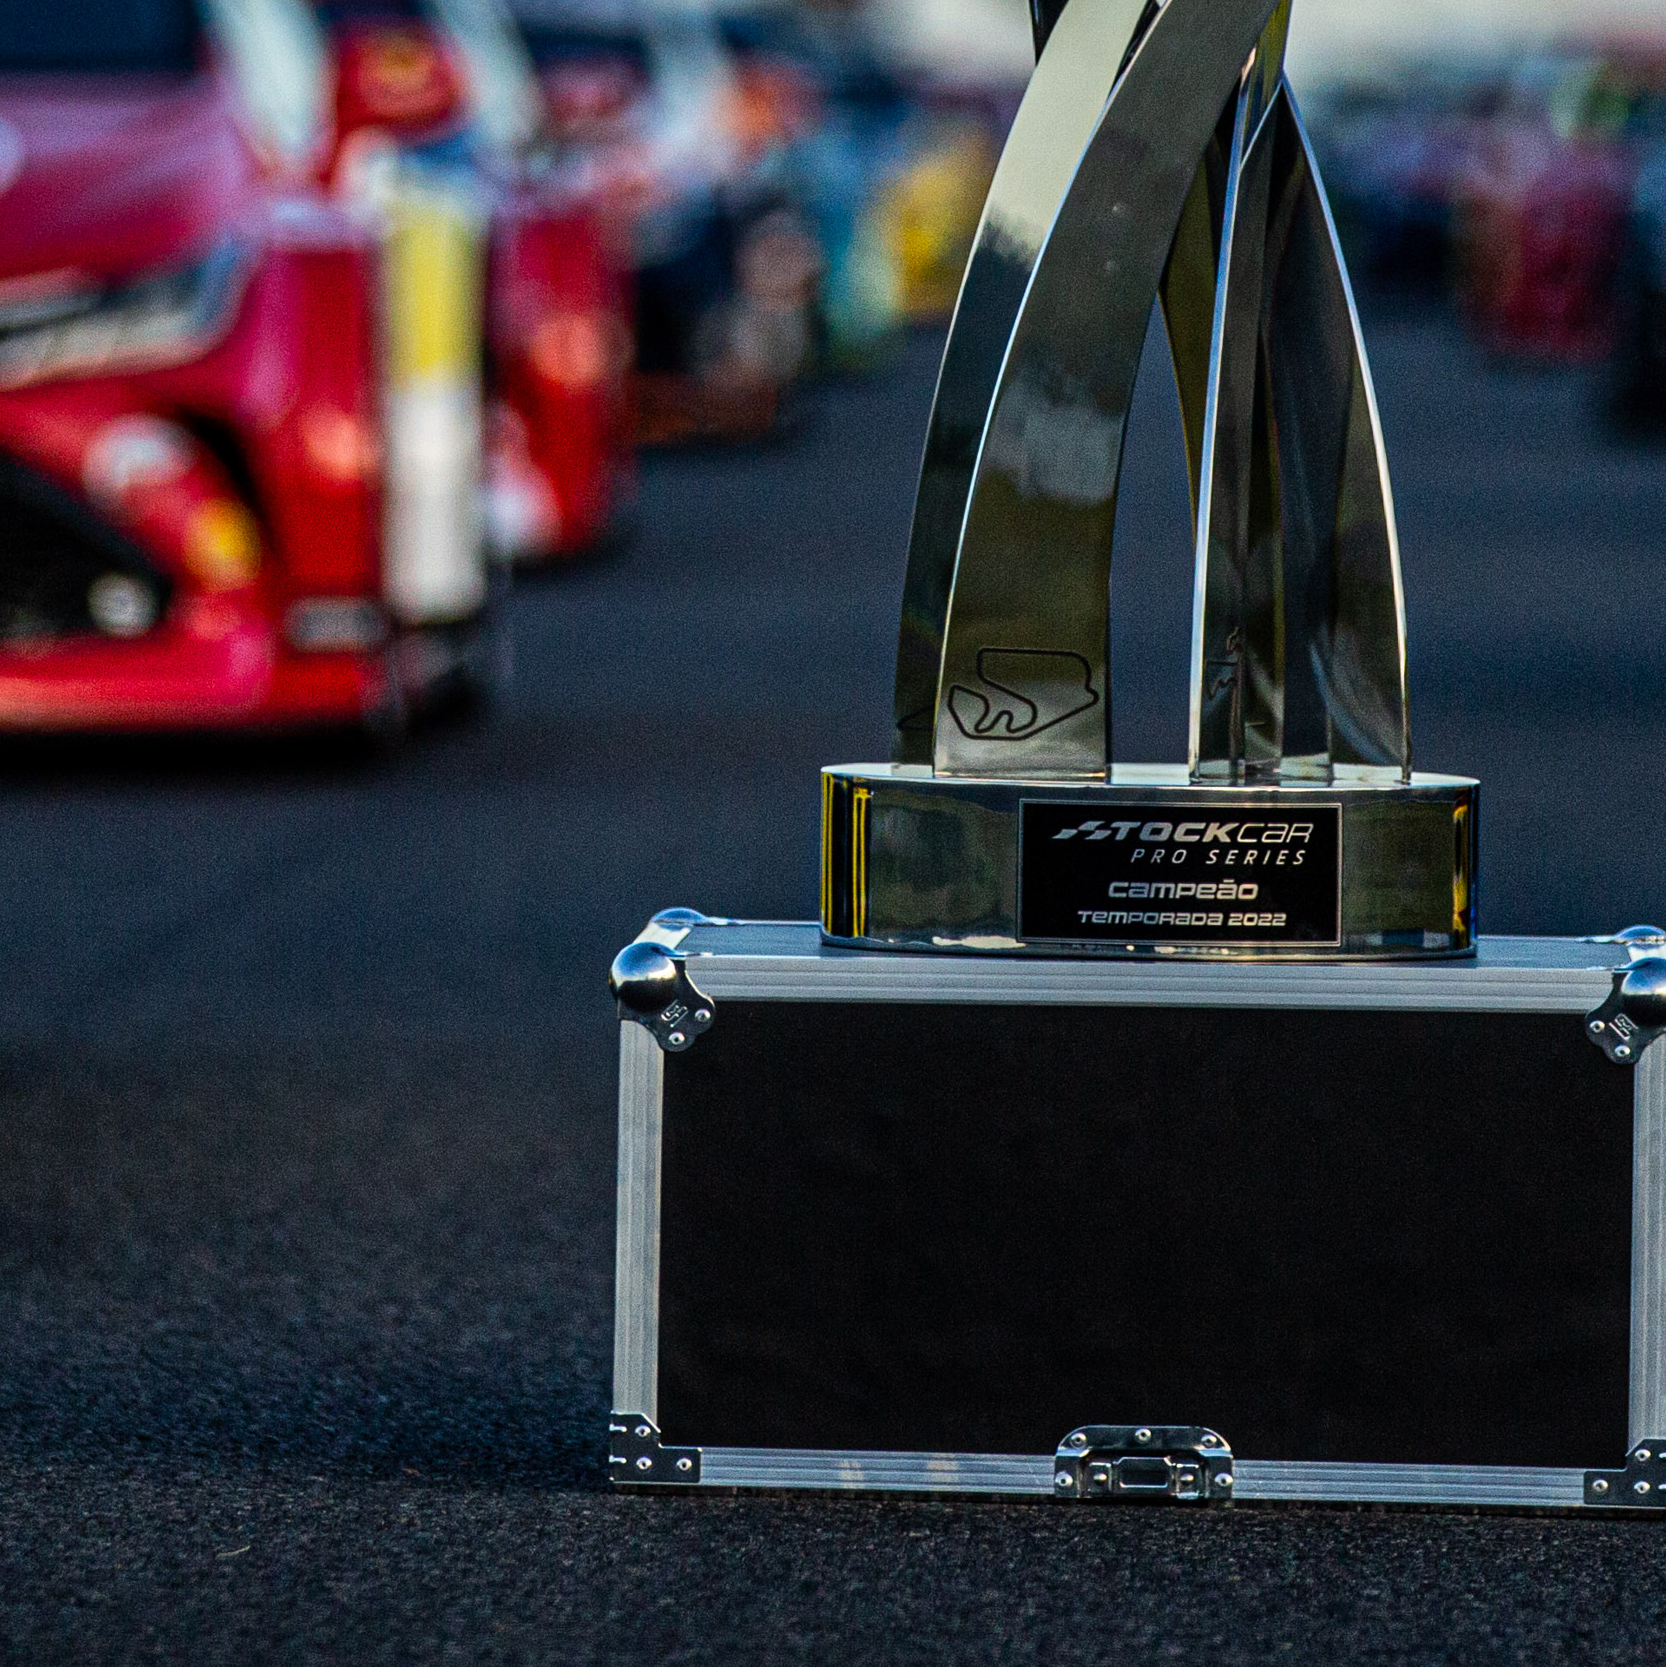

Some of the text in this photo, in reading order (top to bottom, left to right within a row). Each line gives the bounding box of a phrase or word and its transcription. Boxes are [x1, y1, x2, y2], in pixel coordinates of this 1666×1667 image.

[1130, 848, 1307, 866] PRO SERIES
[1227, 912, 1288, 927] 2022
